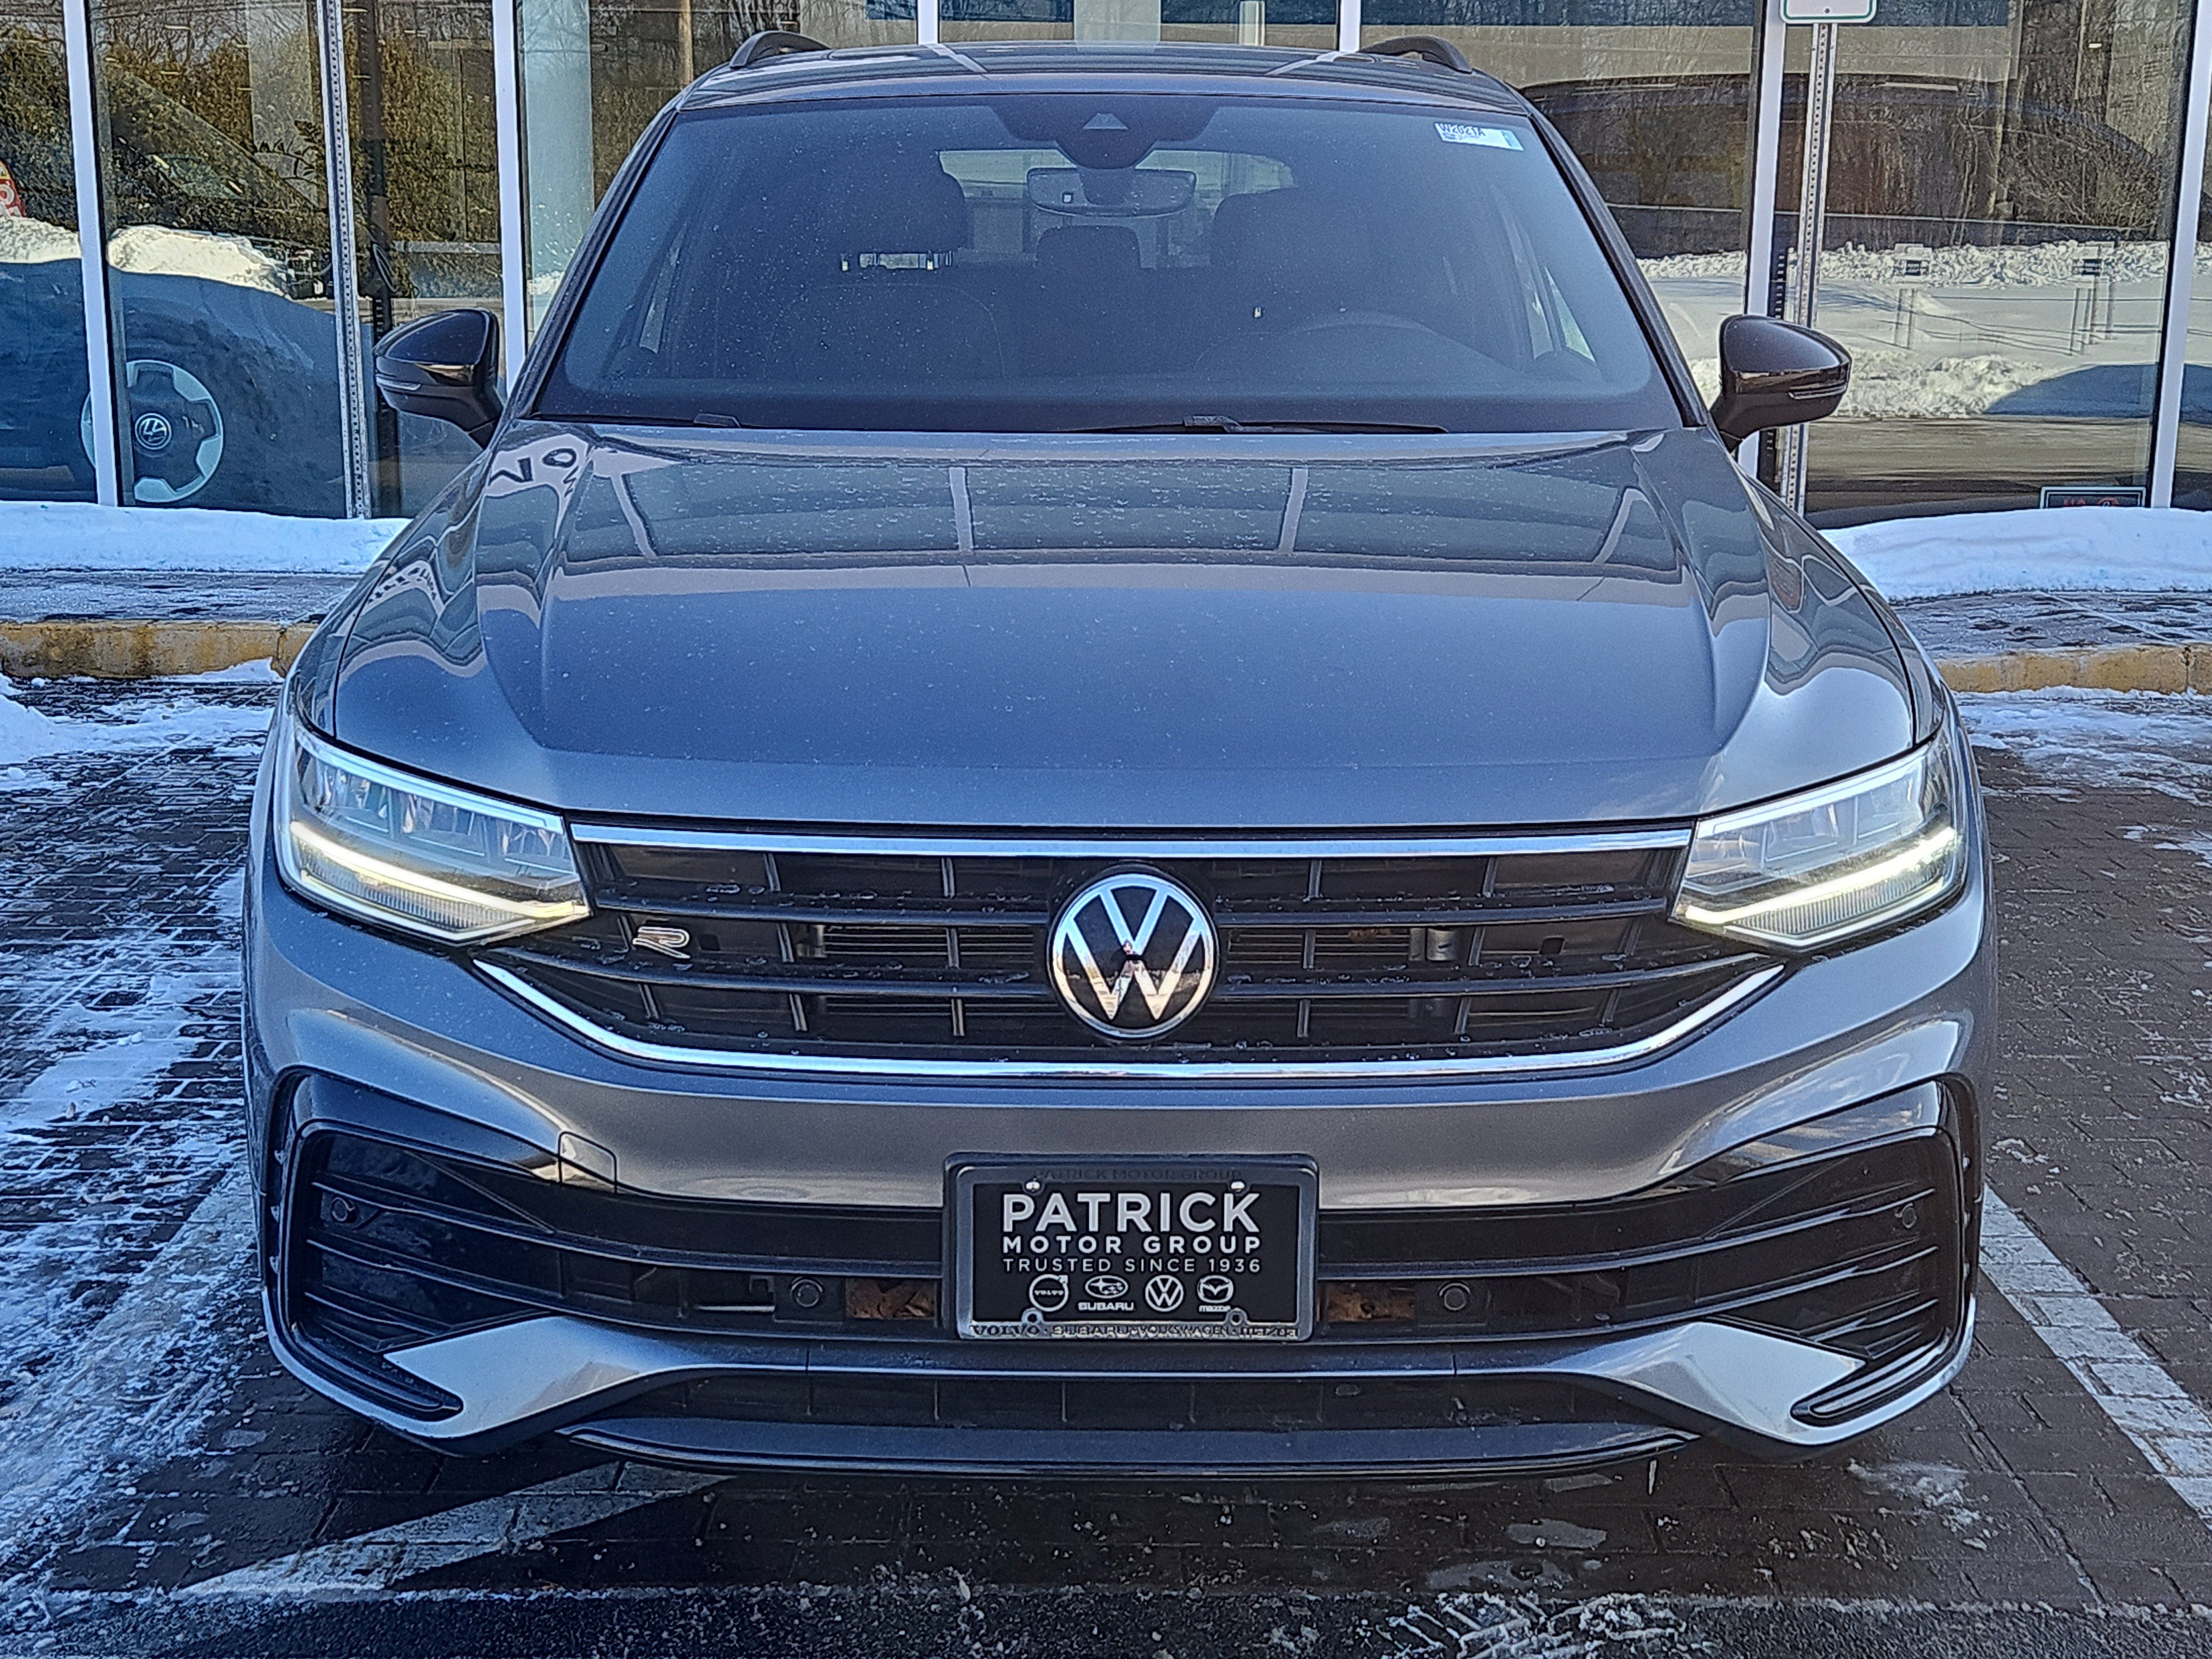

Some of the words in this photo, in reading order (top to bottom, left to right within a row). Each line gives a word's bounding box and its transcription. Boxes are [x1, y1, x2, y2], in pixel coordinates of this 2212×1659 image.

[632, 926, 691, 959] R
[1052, 873, 1214, 1038] VW
[1003, 1192, 1261, 1232] PATRICK
[1003, 1236, 1122, 1254] MOTOR
[1143, 1236, 1261, 1253] GROUP
[1002, 1258, 1111, 1272] TRUSTED
[1124, 1258, 1195, 1272] SINCE
[1208, 1258, 1261, 1272] 1936
[1145, 1275, 1185, 1312] VW
[1078, 1302, 1134, 1311] SUBARU
[970, 1324, 1040, 1336] VOLVO
[1052, 1324, 1129, 1337] SUBARU
[1138, 1324, 1229, 1337] VOLKSWAGEN
